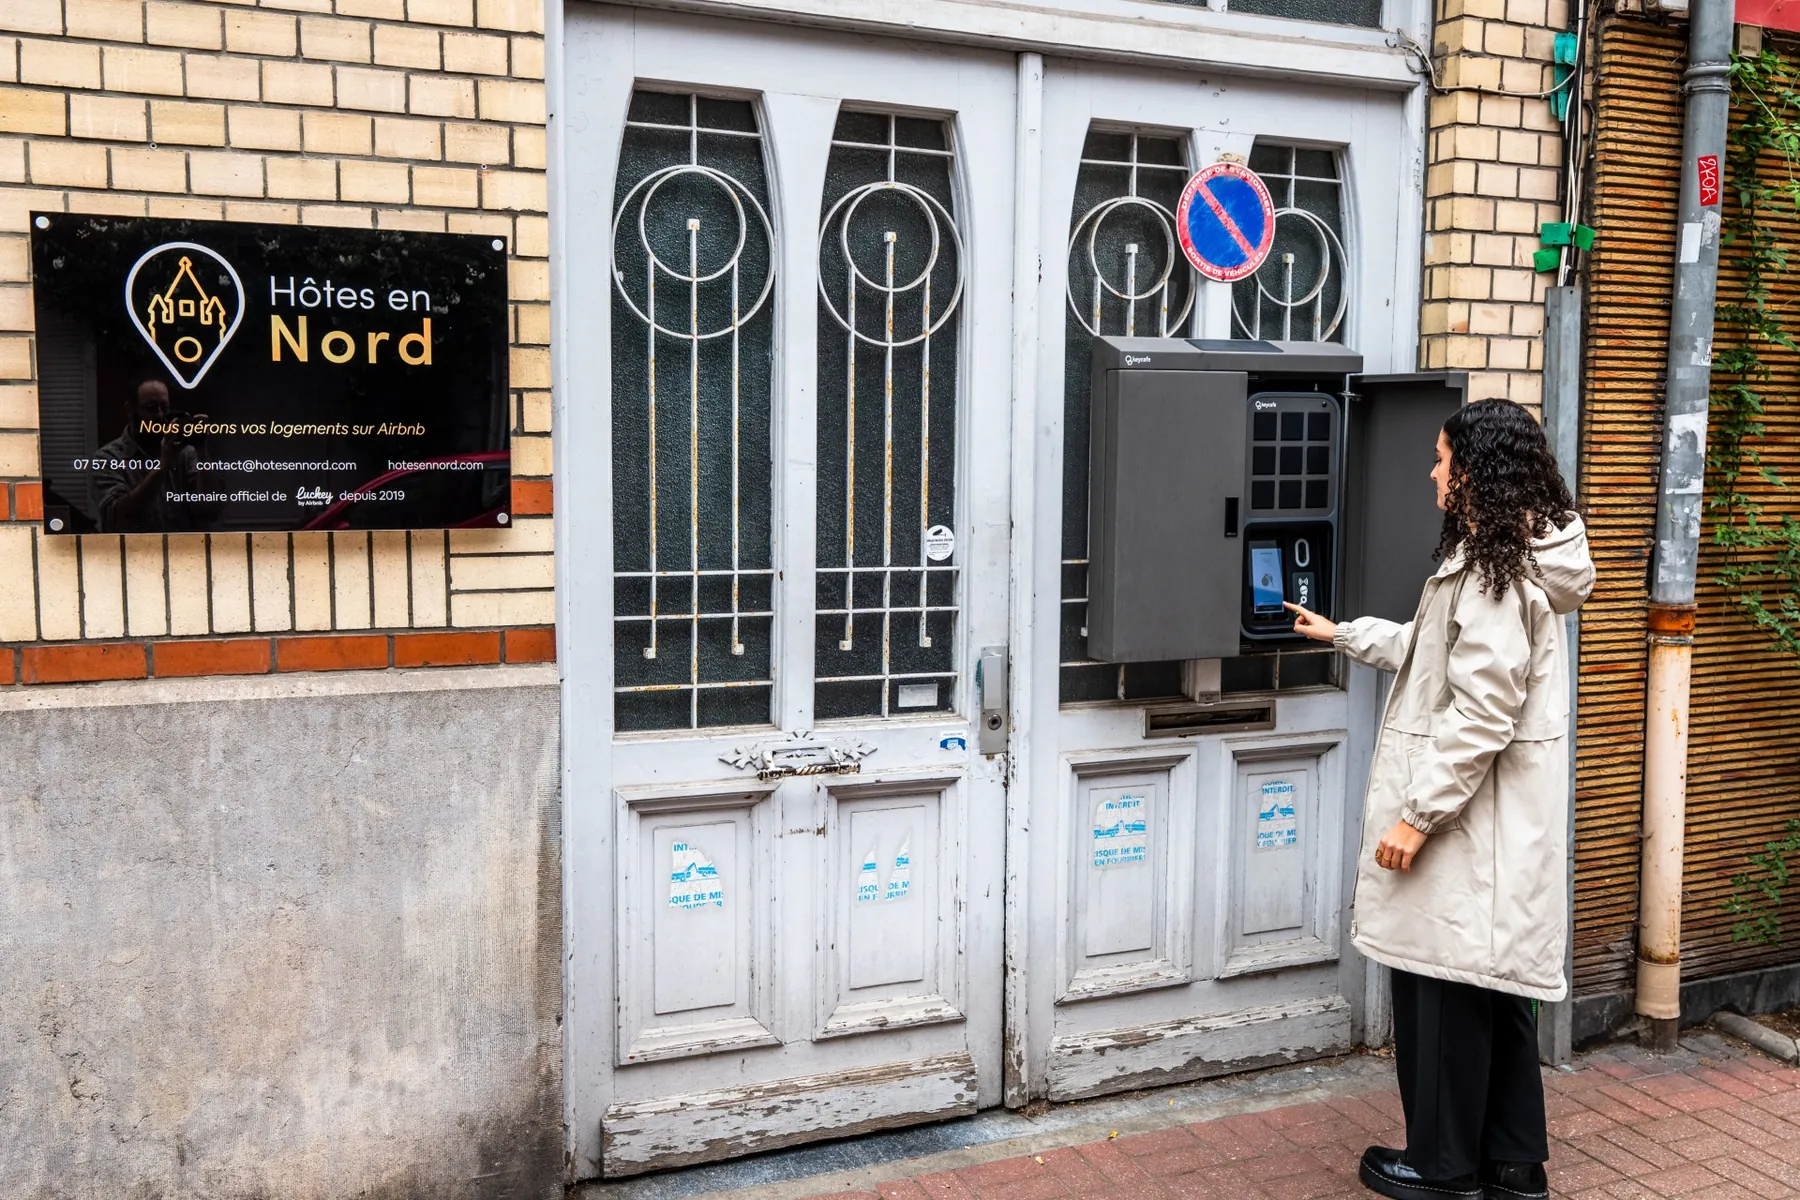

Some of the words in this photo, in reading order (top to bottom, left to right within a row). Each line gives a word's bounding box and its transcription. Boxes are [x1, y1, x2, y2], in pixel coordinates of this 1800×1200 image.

[1229, 166, 1272, 216] STATIONNER
[1187, 247, 1211, 272] SORTIE
[1212, 268, 1223, 276] DE
[268, 274, 376, 311] Hôtes
[387, 288, 432, 313] en
[270, 314, 434, 367] Nord
[138, 419, 181, 434] Nous
[183, 419, 238, 438] gérons
[239, 423, 268, 436] vos
[269, 420, 350, 439] logements
[351, 425, 377, 436] sur
[378, 422, 427, 437] Airbnb
[73, 458, 91, 471] 07
[92, 458, 109, 471] 57
[110, 458, 127, 471] 84
[129, 458, 143, 471] 01
[144, 458, 161, 471] 02
[195, 459, 358, 474] contact@hotesennord.com
[387, 459, 485, 472] hotesennord.com
[165, 490, 228, 503] Partenaire
[229, 490, 269, 503] officiel
[270, 490, 287, 502] de
[339, 490, 378, 505] depuis
[379, 490, 406, 502] 2019
[693, 892, 706, 901] DE
